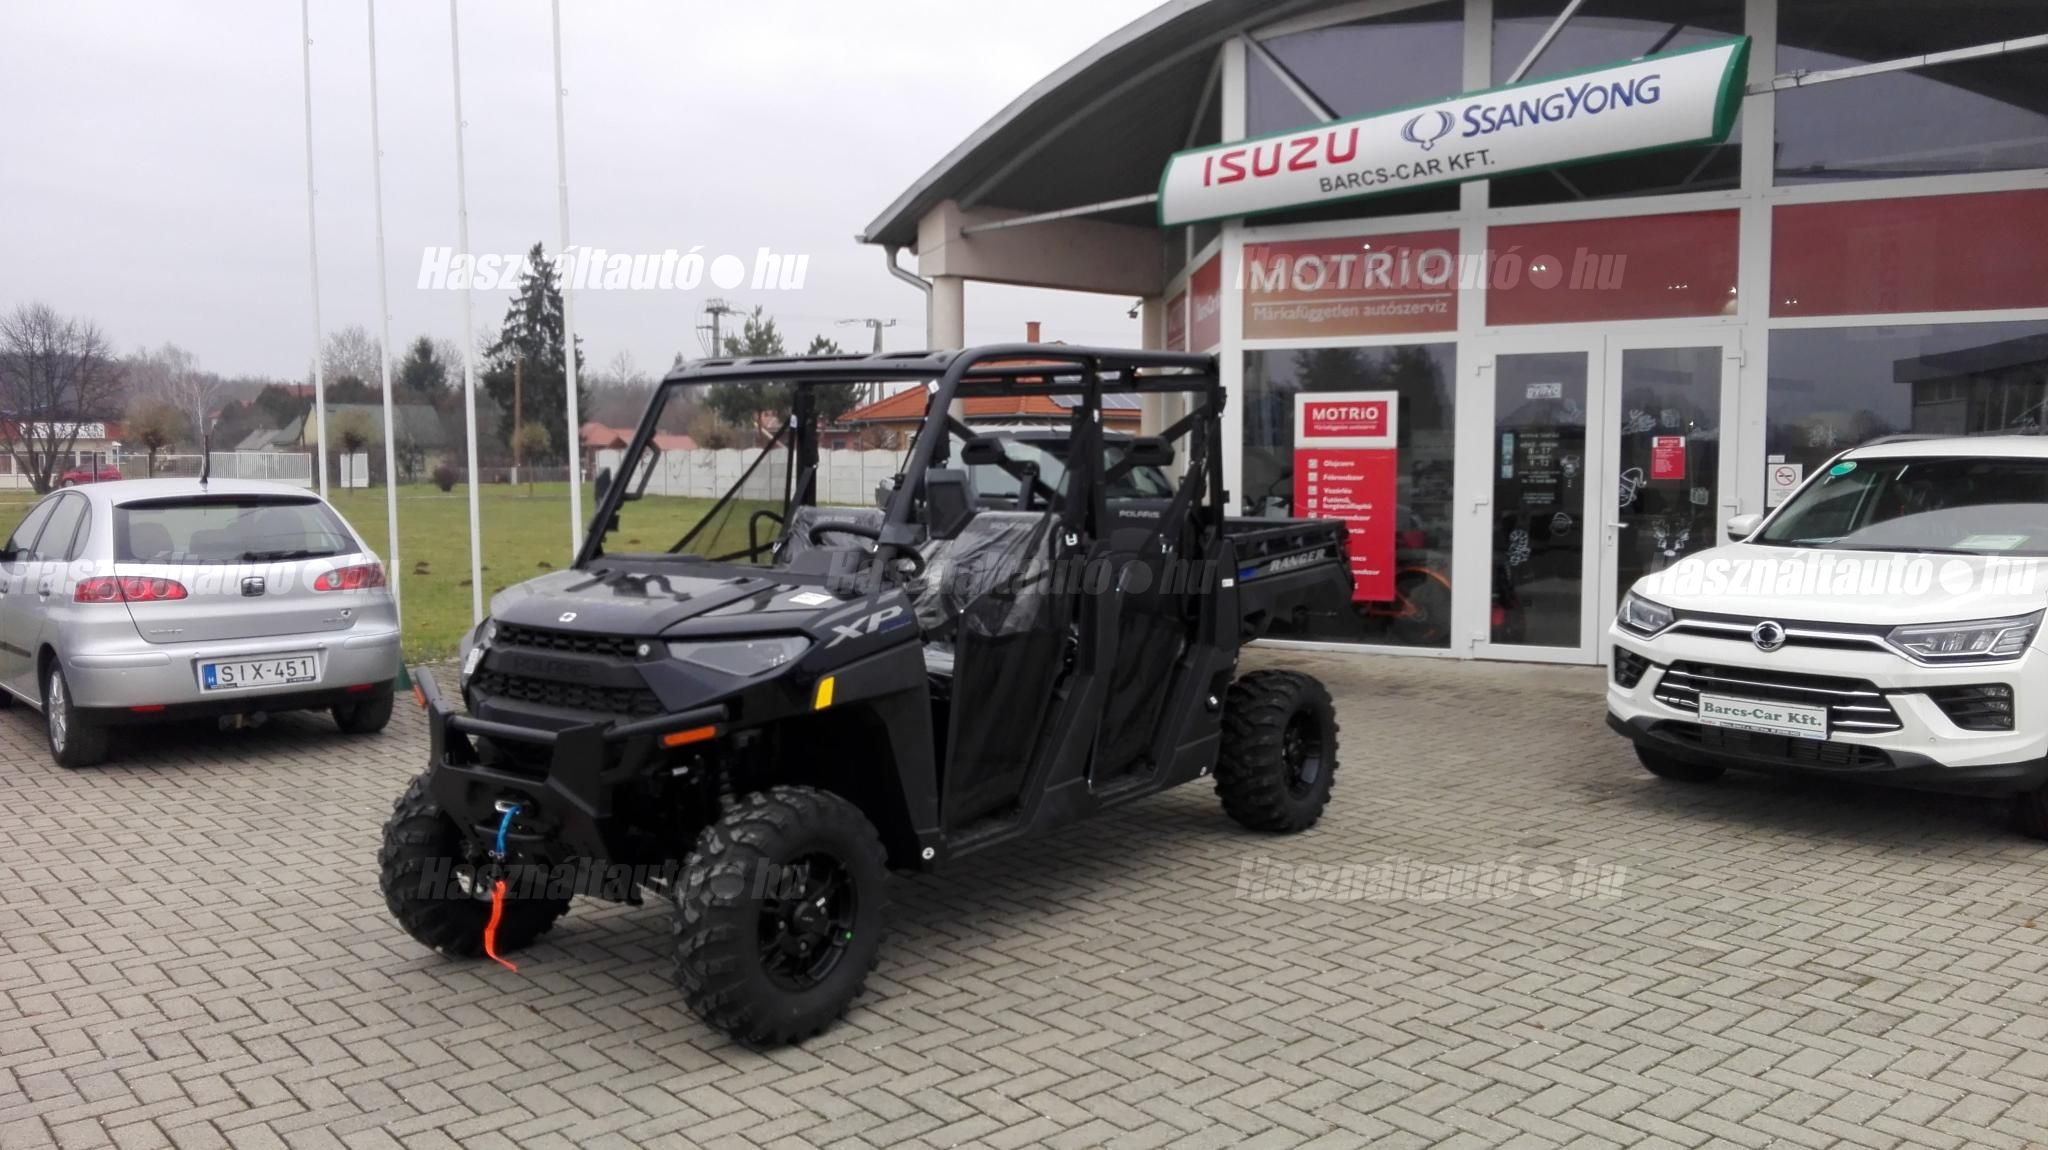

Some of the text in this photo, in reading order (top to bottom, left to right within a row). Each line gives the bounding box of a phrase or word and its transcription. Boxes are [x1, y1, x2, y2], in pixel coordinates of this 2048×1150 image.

[1461, 74, 1661, 139] SSANGYONG
[1203, 127, 1359, 187] ISUZU
[1319, 148, 1496, 193] BARCS-CAR KFT.
[1270, 548, 1326, 572] RANGER
[824, 605, 904, 650] XP
[222, 660, 307, 683] SIX-451
[1703, 701, 1822, 727] Barcs-Car Kft.
